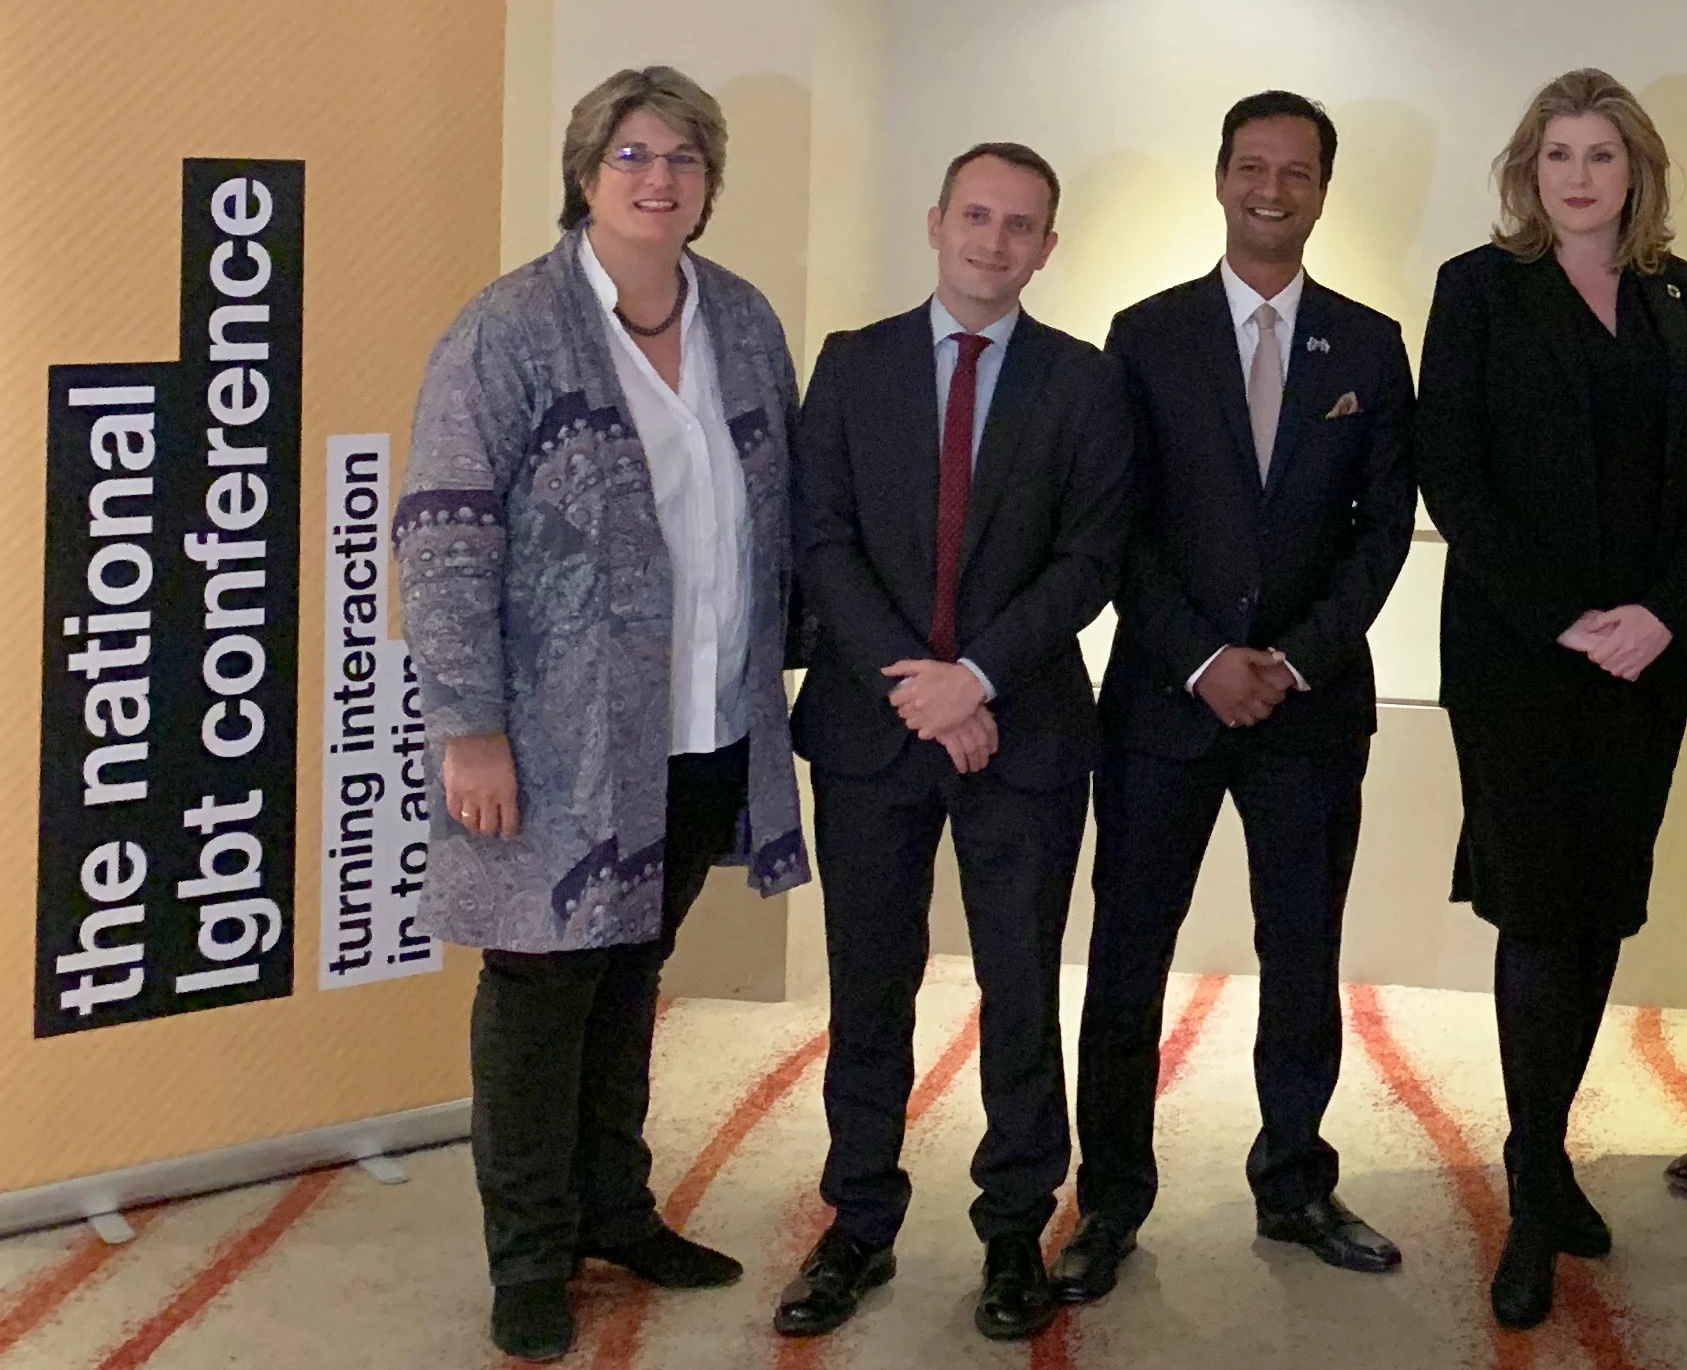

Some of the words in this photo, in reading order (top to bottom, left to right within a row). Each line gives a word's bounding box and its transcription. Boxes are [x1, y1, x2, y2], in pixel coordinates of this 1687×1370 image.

[184, 177, 273, 758] conference
[62, 385, 156, 806] national
[330, 452, 379, 754] interaction
[55, 840, 148, 1016] the
[175, 789, 283, 994] lgbt
[328, 772, 385, 976] turning
[391, 841, 430, 898] to
